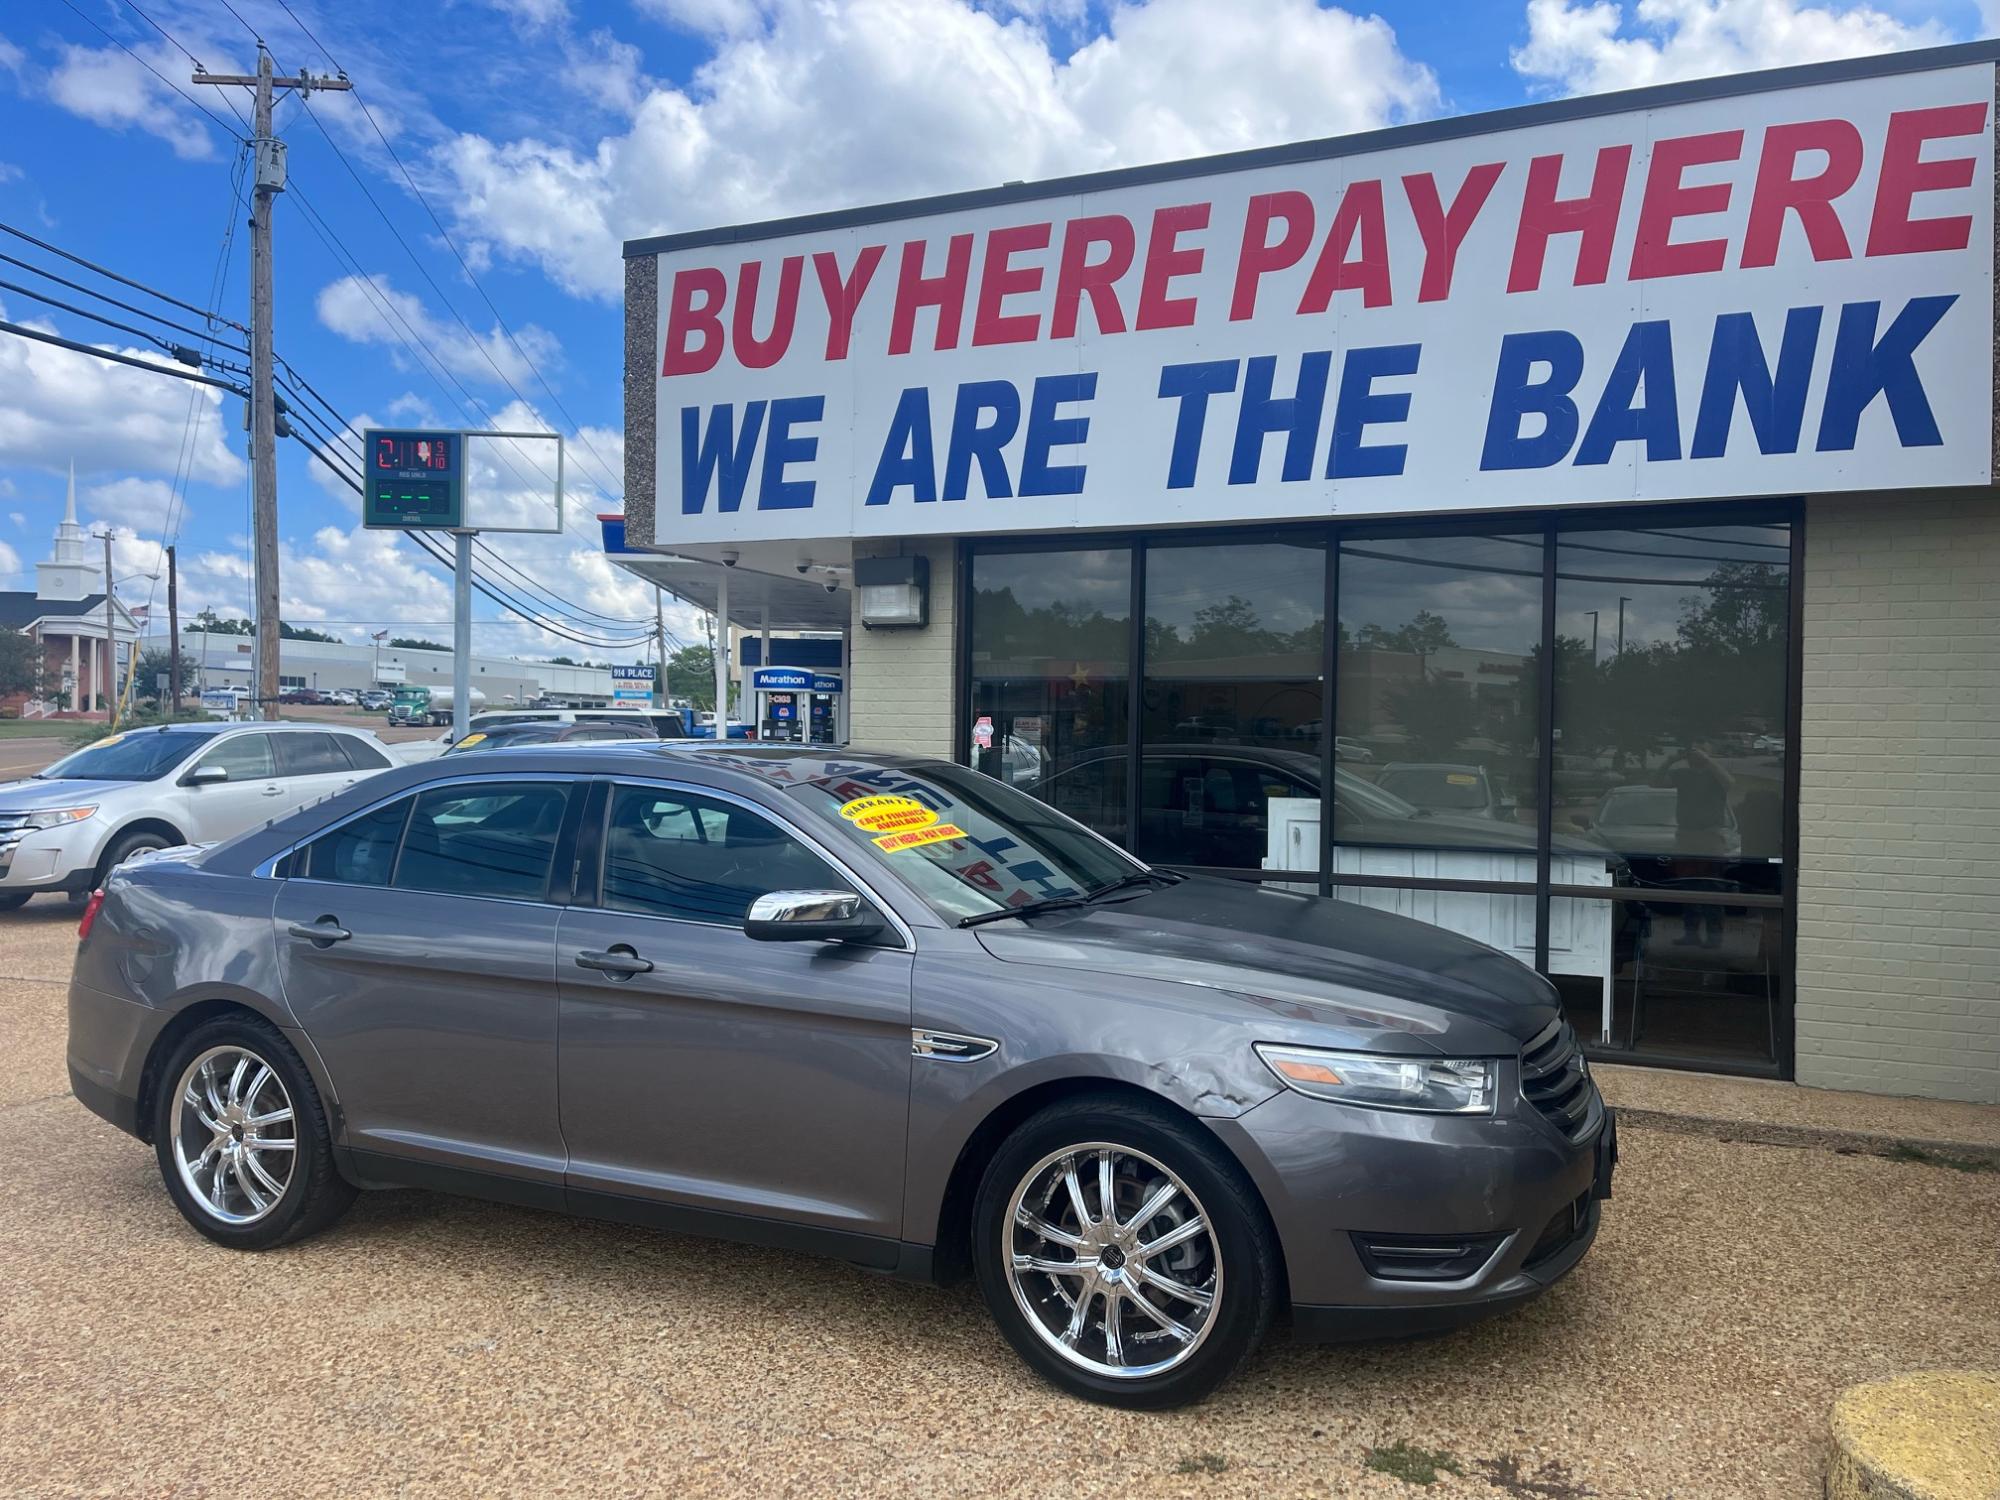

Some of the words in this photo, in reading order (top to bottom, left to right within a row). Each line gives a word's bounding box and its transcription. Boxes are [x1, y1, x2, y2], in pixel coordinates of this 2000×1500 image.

[664, 247, 884, 376] BUY
[889, 192, 1209, 355] HERE
[1231, 164, 1504, 321] PAY
[1507, 105, 1986, 293] HERE
[681, 395, 825, 515] WE
[865, 372, 1098, 506] ARE
[1157, 344, 1422, 490] THE
[1479, 294, 1960, 471] BANK
[613, 668, 625, 677] 914
[627, 669, 653, 678] PLACE
[760, 675, 806, 685] Marathon
[844, 799, 913, 817] WARRANTY
[858, 815, 885, 825] EASY
[886, 808, 928, 820] FINANCE
[876, 816, 929, 830] AVAILABLE
